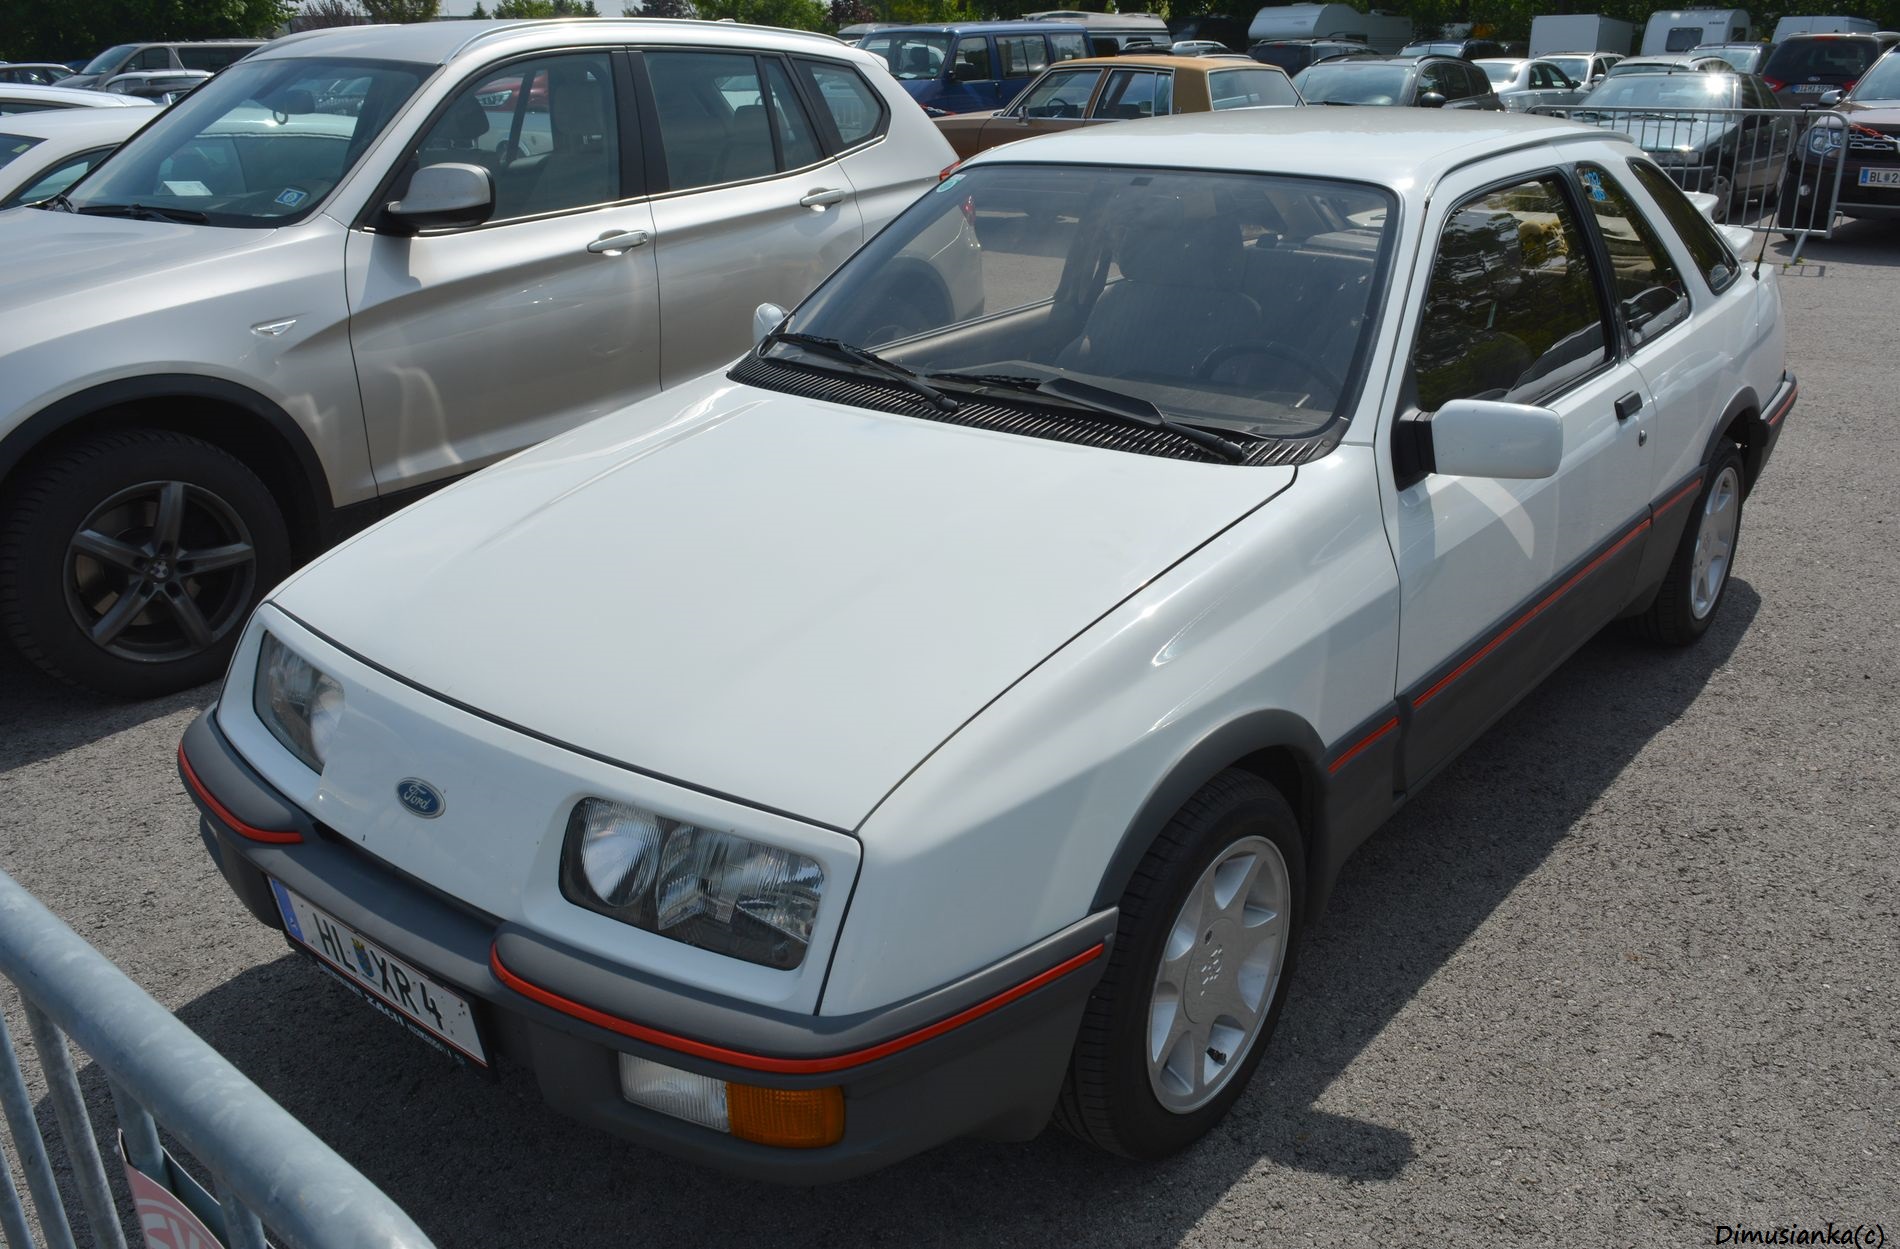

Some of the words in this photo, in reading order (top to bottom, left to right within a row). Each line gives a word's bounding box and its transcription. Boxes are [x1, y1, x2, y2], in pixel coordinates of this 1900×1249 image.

[1870, 171, 1883, 182] BL
[403, 785, 431, 810] Ford
[313, 912, 357, 973] HL
